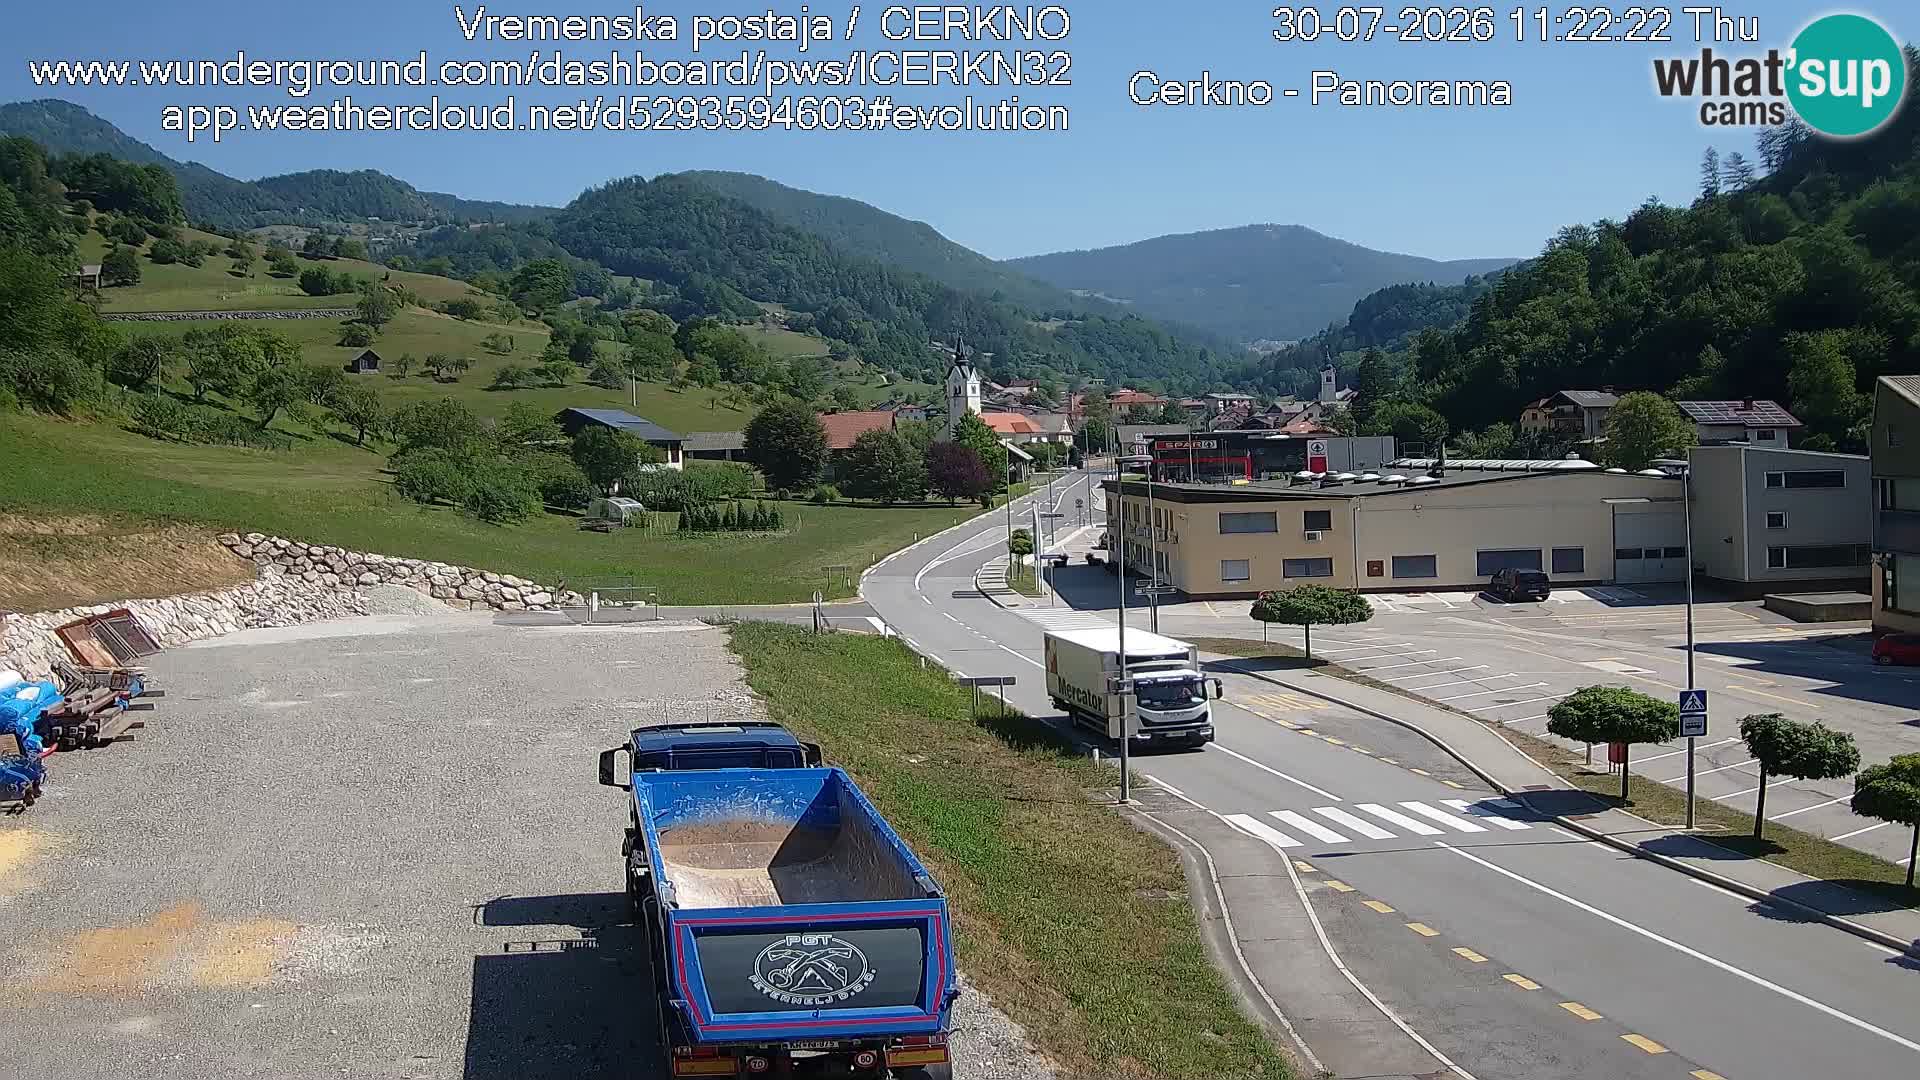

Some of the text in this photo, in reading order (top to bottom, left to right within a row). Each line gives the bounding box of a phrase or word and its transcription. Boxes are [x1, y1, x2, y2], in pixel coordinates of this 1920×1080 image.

[1165, 441, 1201, 449] SPAR
[1057, 675, 1102, 712] Mercator
[785, 934, 833, 947] PGT
[747, 974, 834, 1005] PETERNELJ
